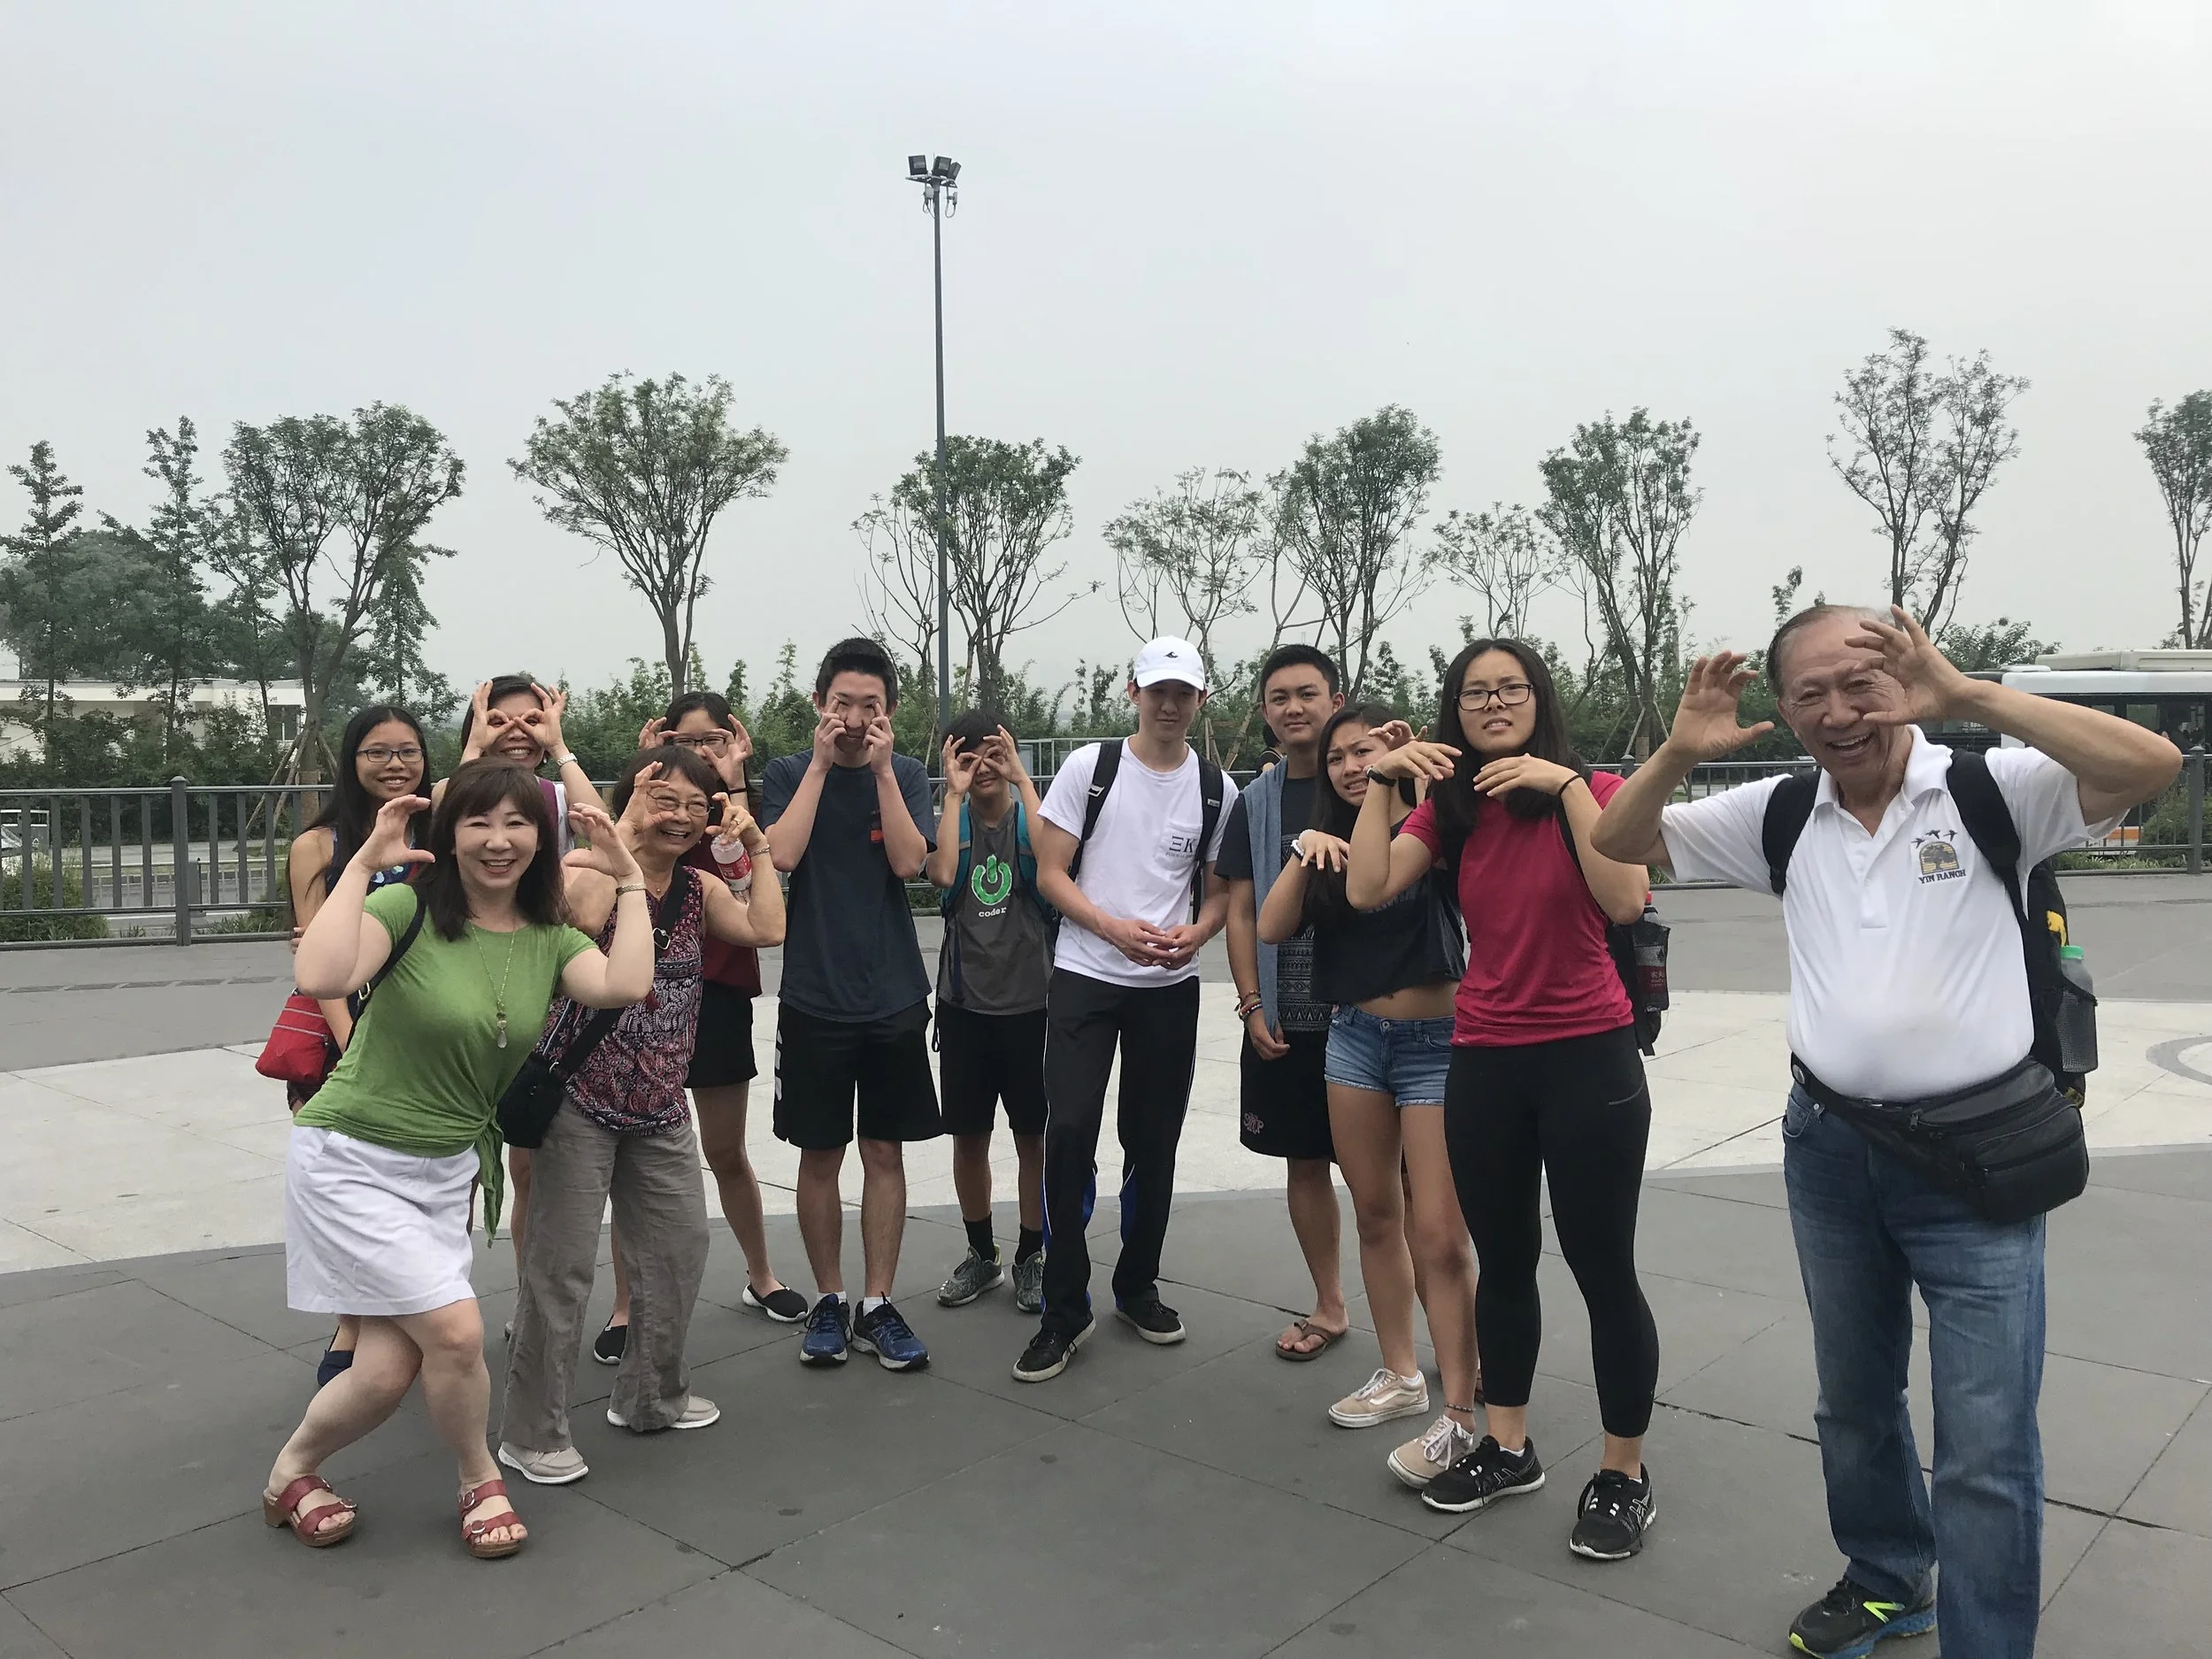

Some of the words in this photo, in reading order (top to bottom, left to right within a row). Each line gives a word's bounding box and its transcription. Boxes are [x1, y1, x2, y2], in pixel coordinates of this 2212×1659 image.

[1918, 874, 1935, 884] YIN
[1936, 869, 1966, 881] RANCH
[978, 906, 1007, 918] coder
